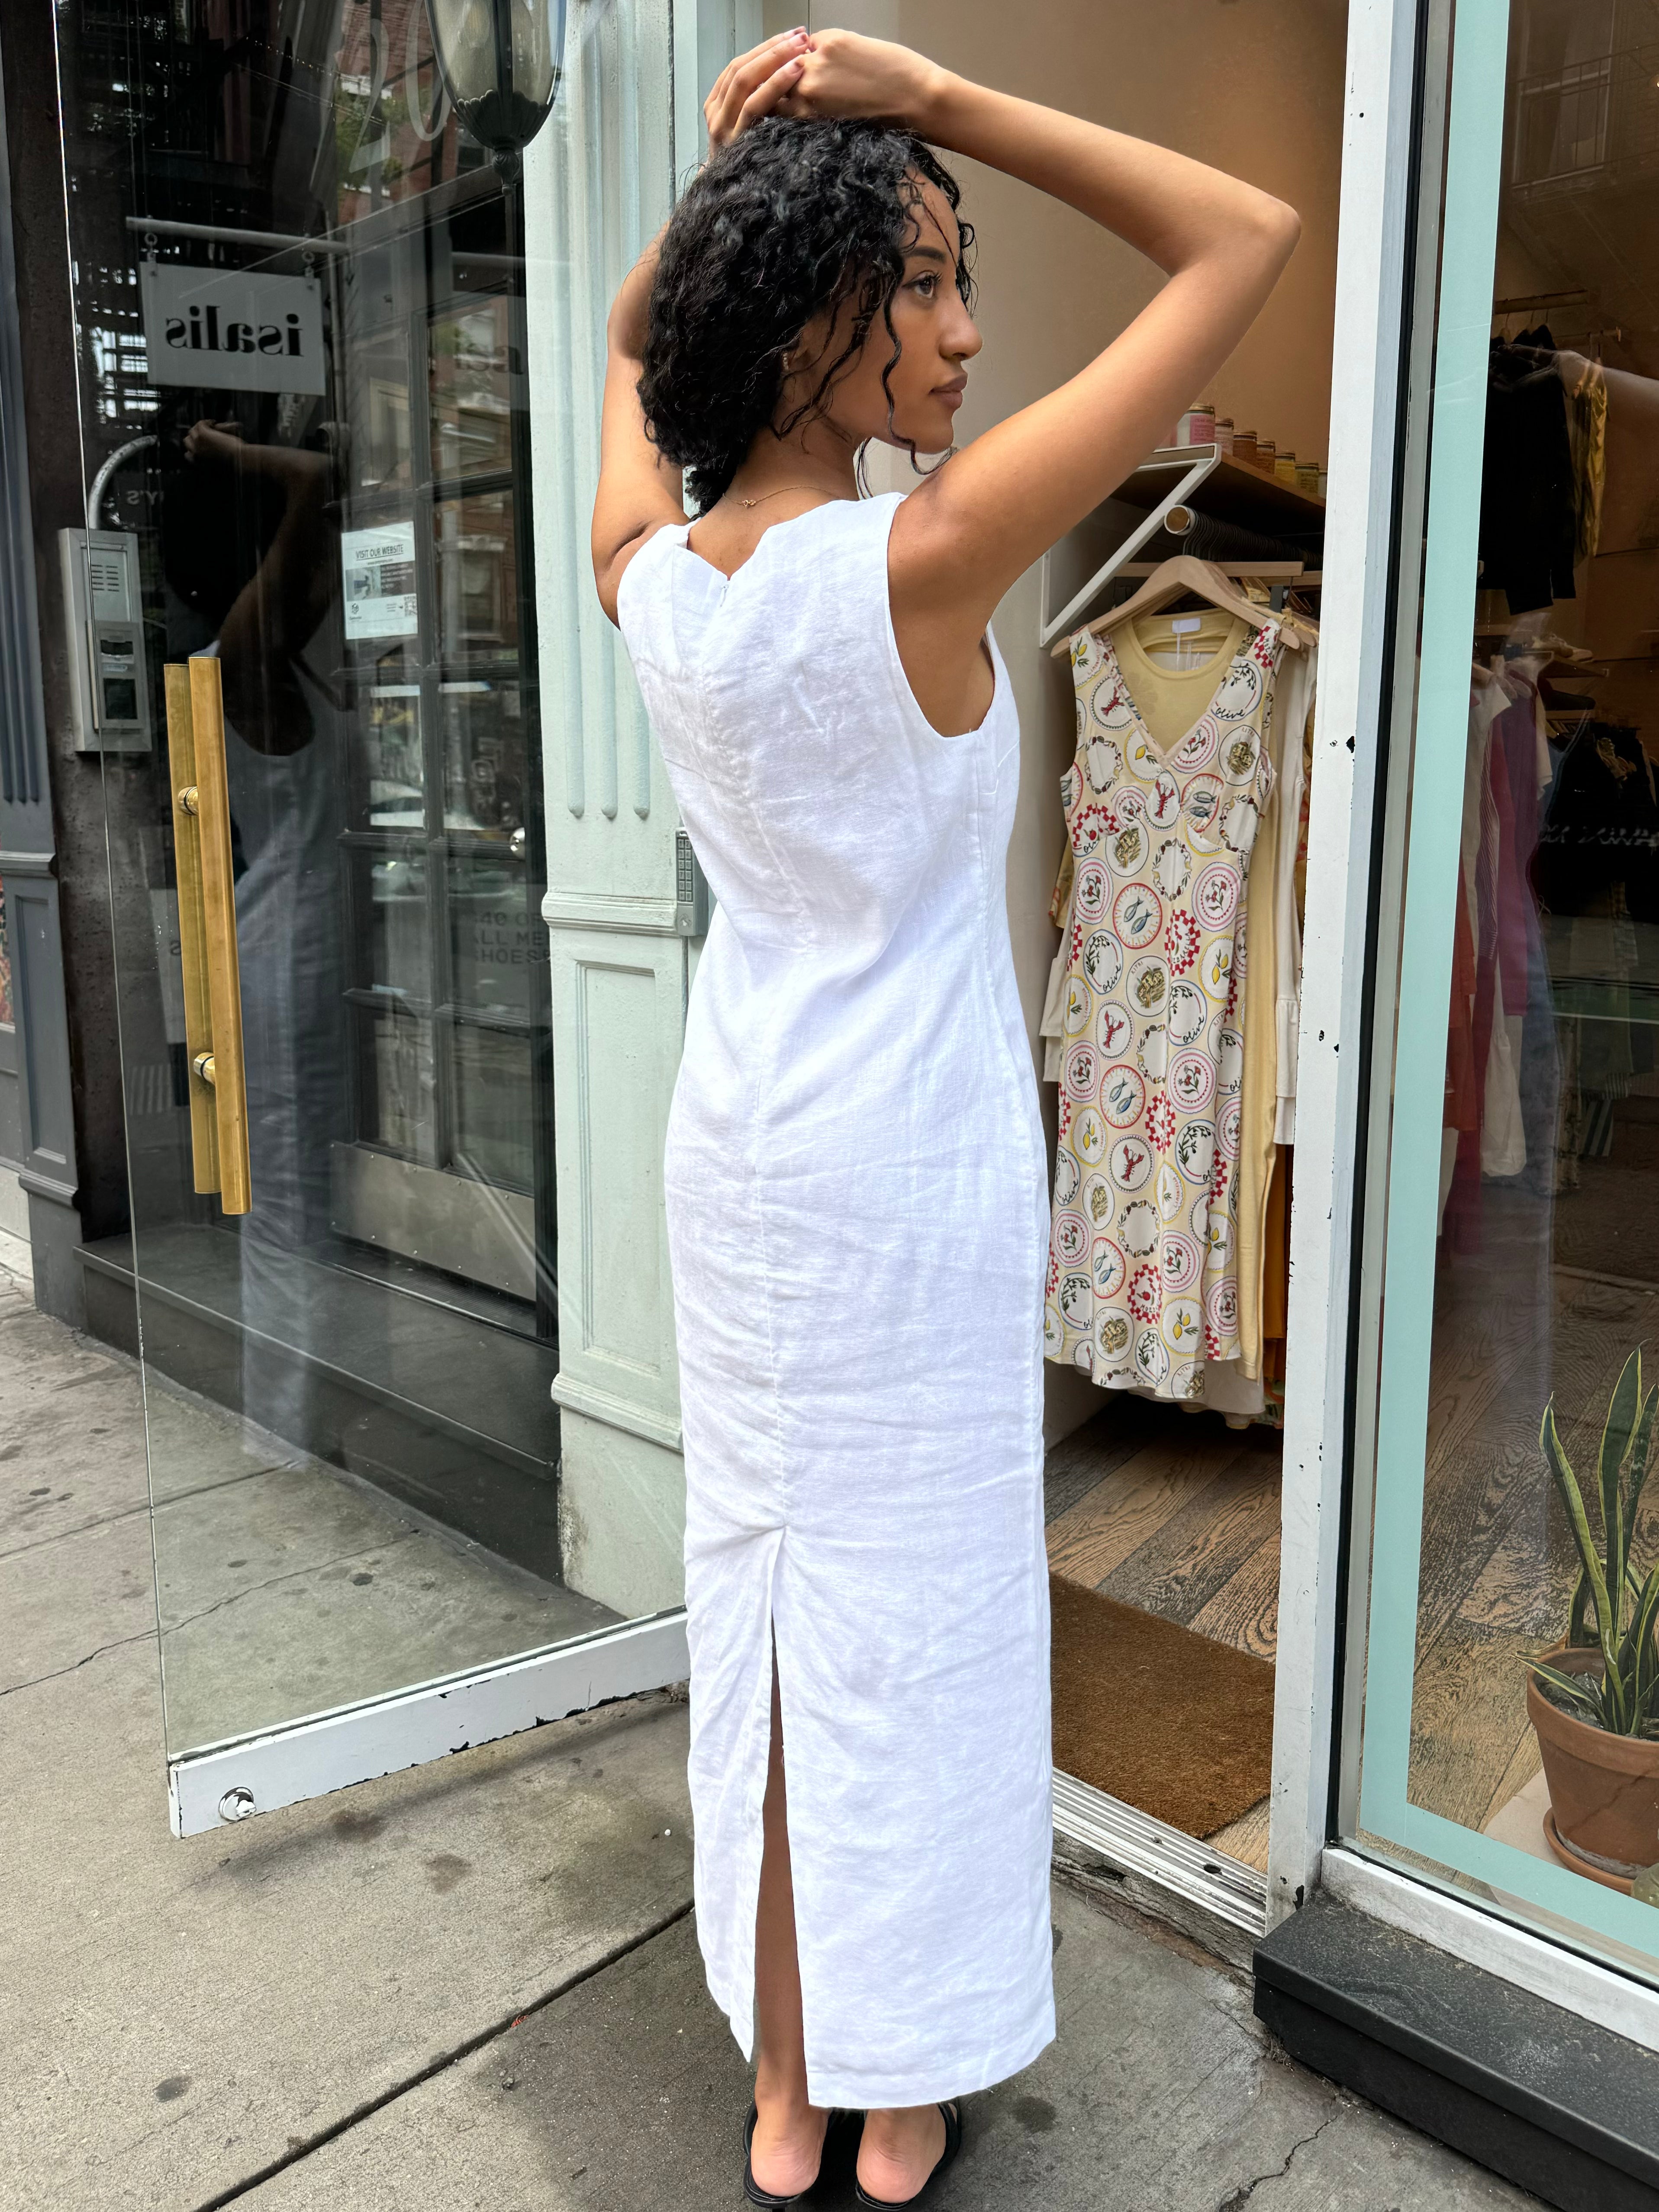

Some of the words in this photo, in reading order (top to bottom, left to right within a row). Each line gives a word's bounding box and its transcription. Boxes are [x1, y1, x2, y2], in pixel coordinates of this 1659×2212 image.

[356, 549, 368, 559] VISIT
[370, 548, 381, 557] OUR
[382, 544, 404, 554] WEBSITE
[1215, 707, 1245, 719] olive
[1103, 964, 1121, 992] olive
[1183, 1015, 1204, 1038] olive
